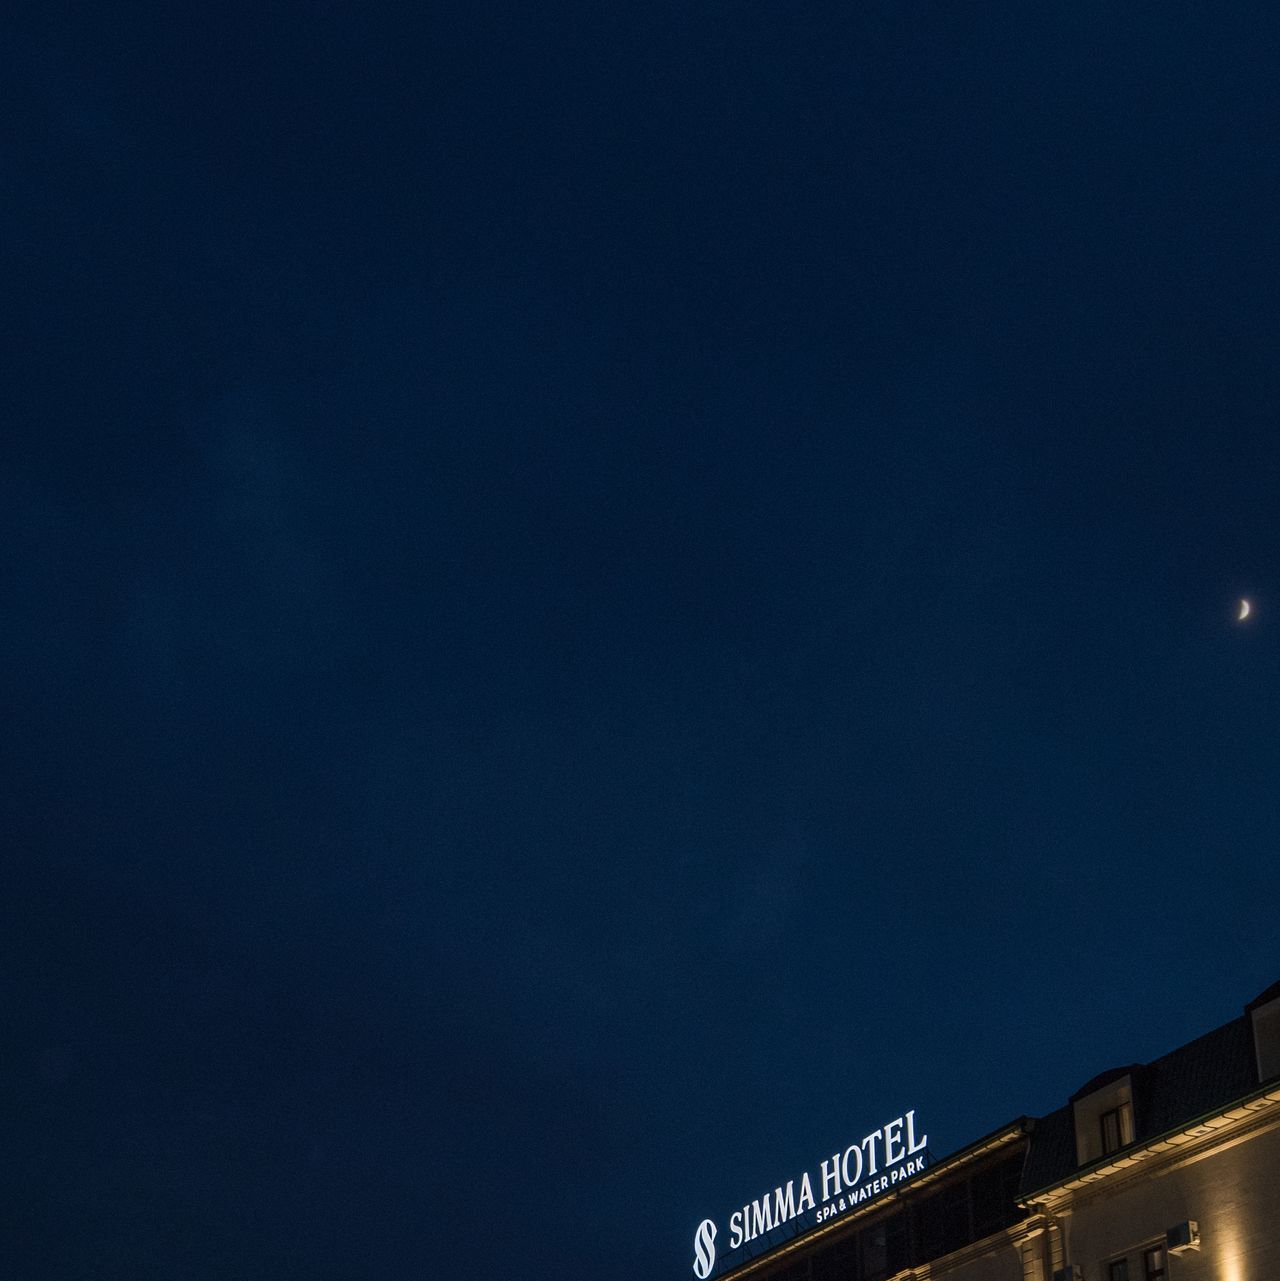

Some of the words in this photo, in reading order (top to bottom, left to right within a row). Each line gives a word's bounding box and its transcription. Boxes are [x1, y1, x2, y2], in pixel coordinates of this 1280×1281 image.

[729, 1172, 816, 1249] SIMMA
[820, 1109, 928, 1202] HOTEL
[816, 1203, 838, 1224] SPA
[838, 1198, 847, 1213] &
[848, 1175, 889, 1206] WATER
[890, 1155, 925, 1184] PARK
